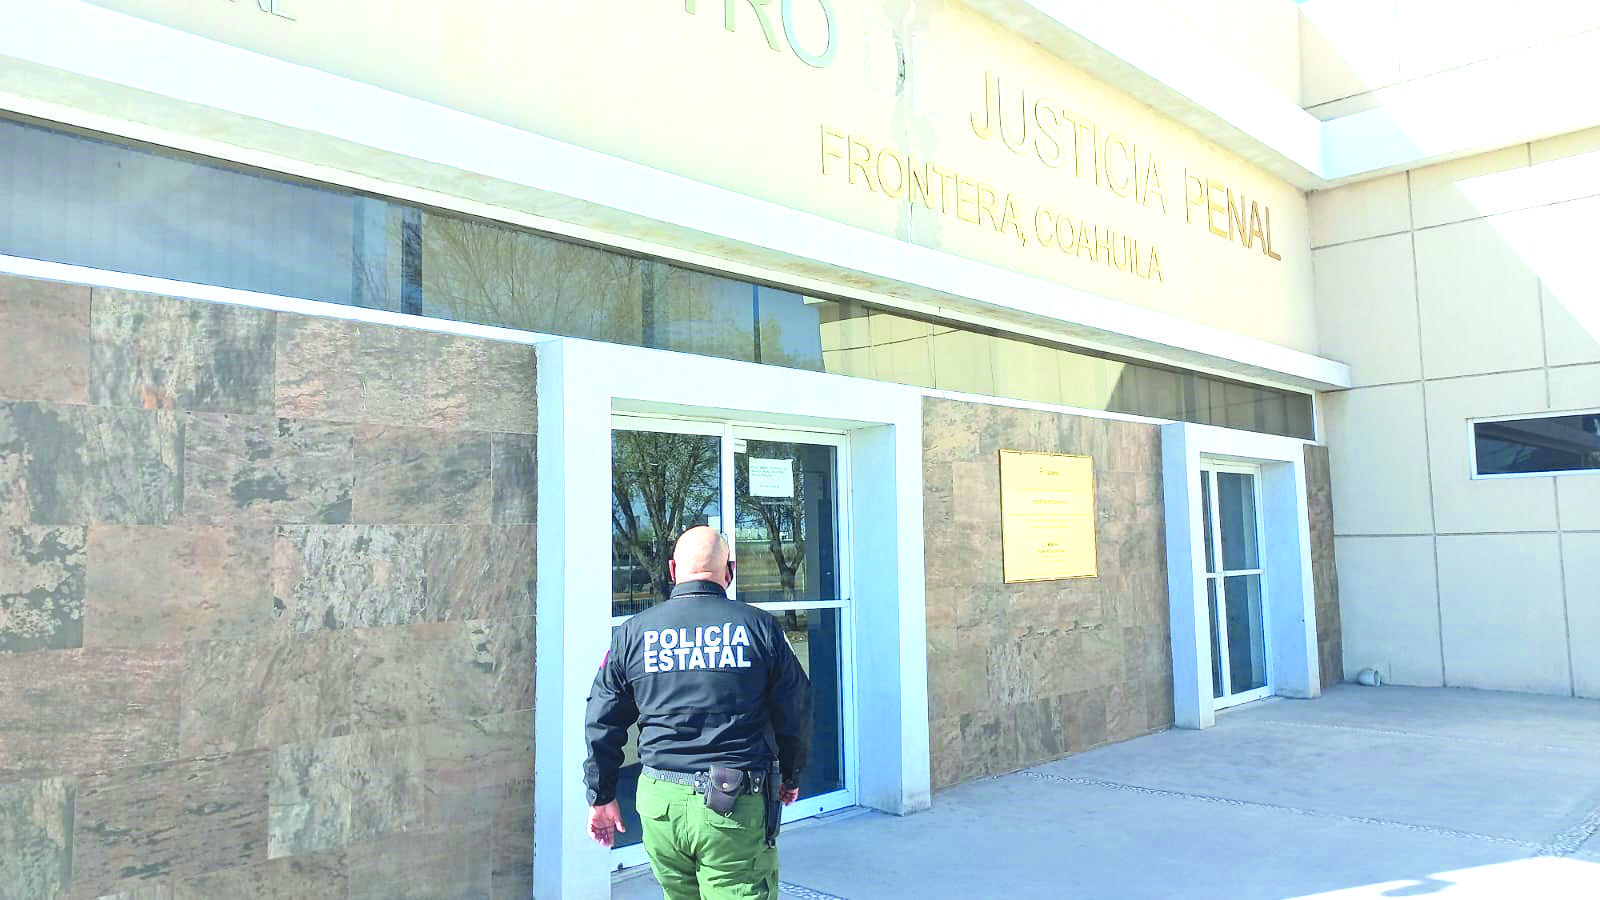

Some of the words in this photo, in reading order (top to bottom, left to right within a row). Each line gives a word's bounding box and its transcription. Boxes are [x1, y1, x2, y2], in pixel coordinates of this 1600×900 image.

[821, 125, 1025, 246] FRONTERA,
[1035, 206, 1163, 281] COAHUILA
[970, 71, 1165, 212] JUSTICIA
[1185, 171, 1281, 260] PENAL
[643, 622, 751, 651] POLICÍA
[643, 646, 752, 673] ESTATAL
